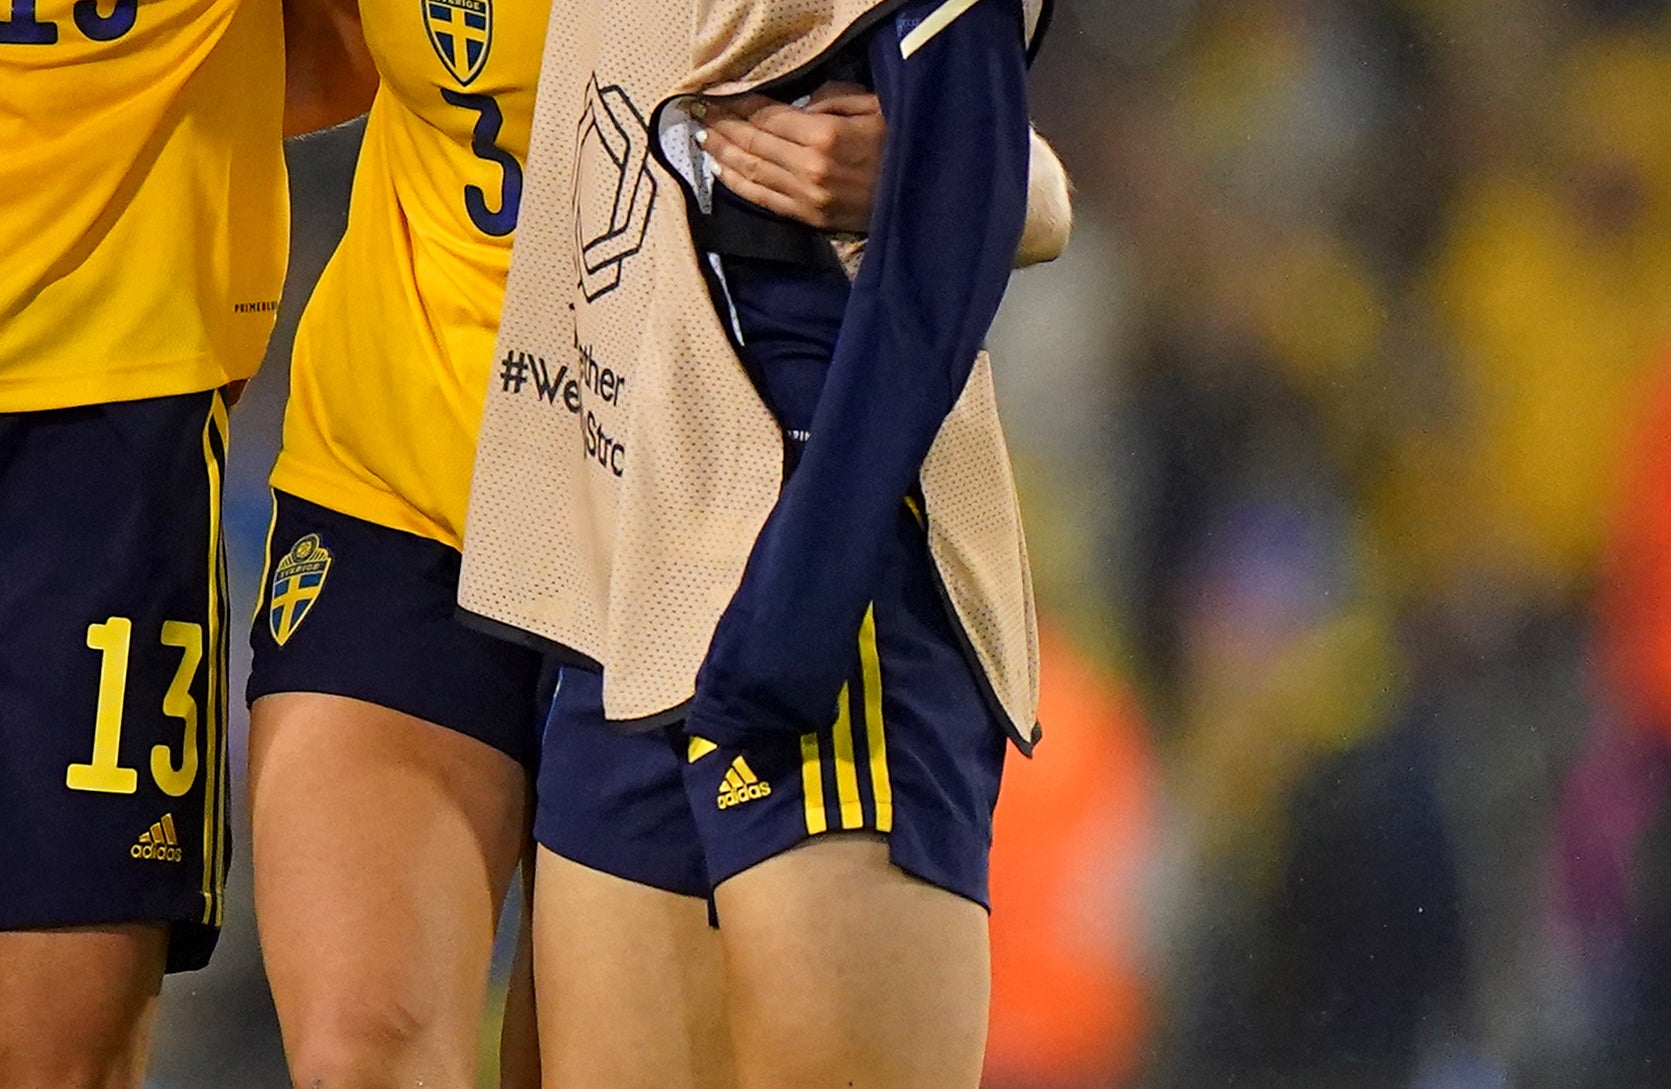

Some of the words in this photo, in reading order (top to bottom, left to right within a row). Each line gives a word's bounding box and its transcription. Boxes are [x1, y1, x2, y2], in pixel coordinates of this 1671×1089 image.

[441, 87, 523, 237] 3
[66, 616, 203, 797] 13
[717, 781, 771, 810] adidas
[130, 842, 182, 863] adidas
